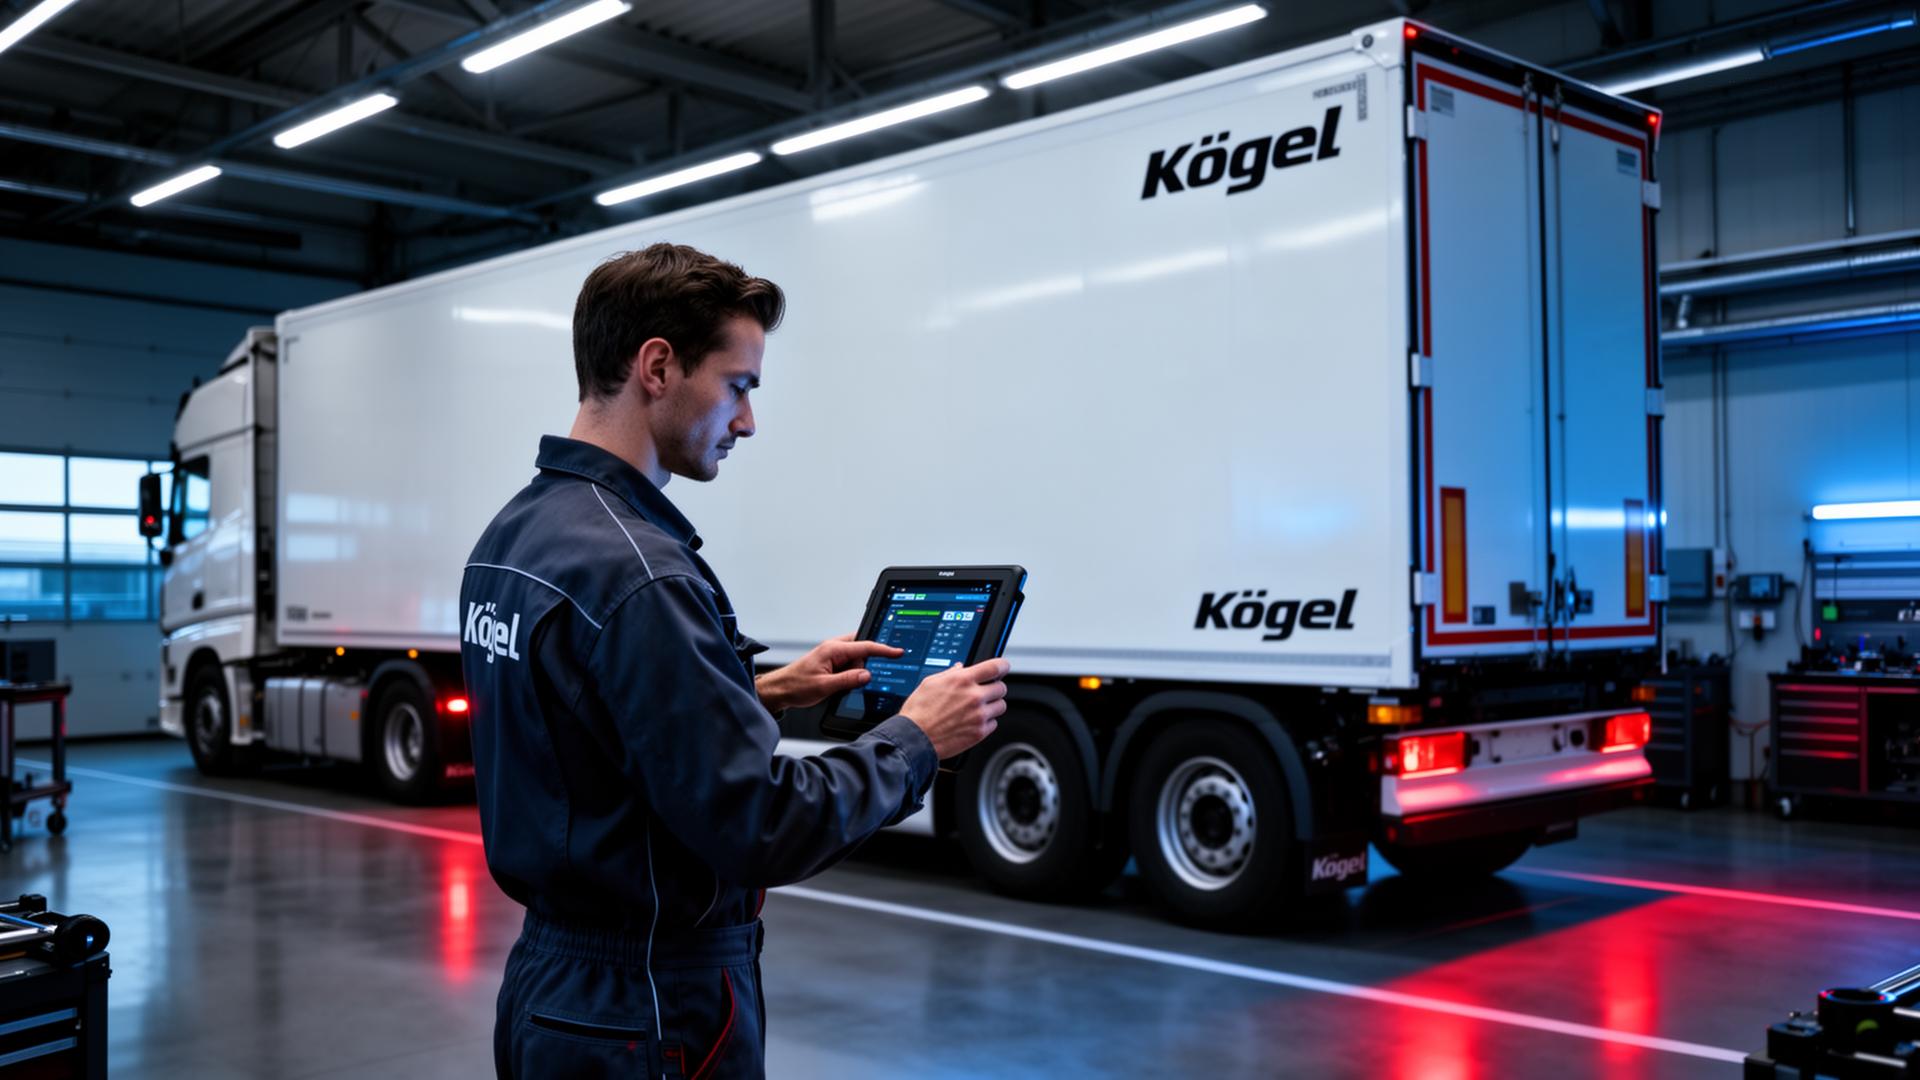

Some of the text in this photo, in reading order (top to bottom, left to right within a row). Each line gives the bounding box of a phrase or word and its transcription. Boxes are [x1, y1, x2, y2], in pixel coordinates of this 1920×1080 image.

[1141, 105, 1342, 200] Kögel
[1194, 589, 1358, 641] Kögel
[1312, 852, 1366, 881] Kögel
